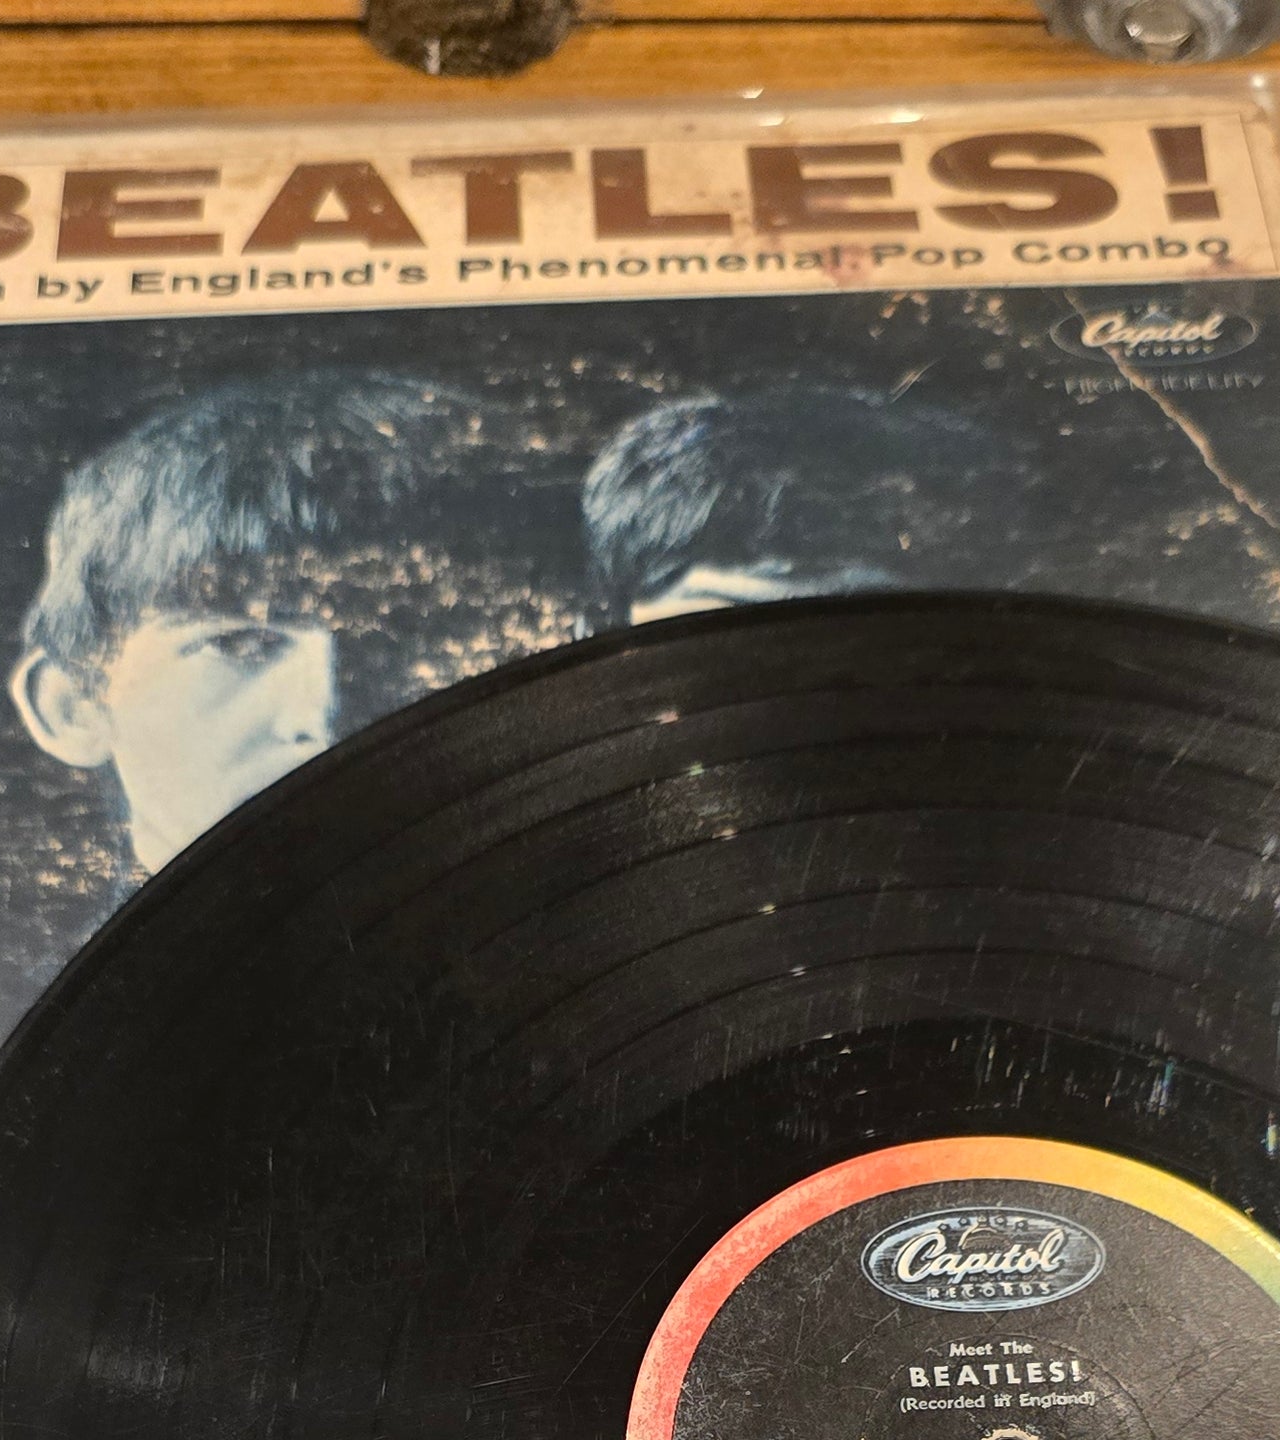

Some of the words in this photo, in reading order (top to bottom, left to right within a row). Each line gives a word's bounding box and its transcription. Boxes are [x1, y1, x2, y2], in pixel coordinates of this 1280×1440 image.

[35, 272, 103, 302] by
[131, 260, 428, 294] England's
[458, 244, 841, 283] Phenomenal
[870, 240, 983, 270] Pop
[1012, 232, 1231, 265] Combo
[1081, 311, 1227, 348] Capitol
[897, 1228, 1067, 1284] Capitol
[927, 1282, 1051, 1300] RECORDS
[949, 1342, 993, 1358] Meet
[1000, 1340, 1034, 1355] The
[909, 1360, 1082, 1388] BEATLES!
[900, 1395, 985, 1413] (Recorded
[1019, 1390, 1097, 1409] England)
